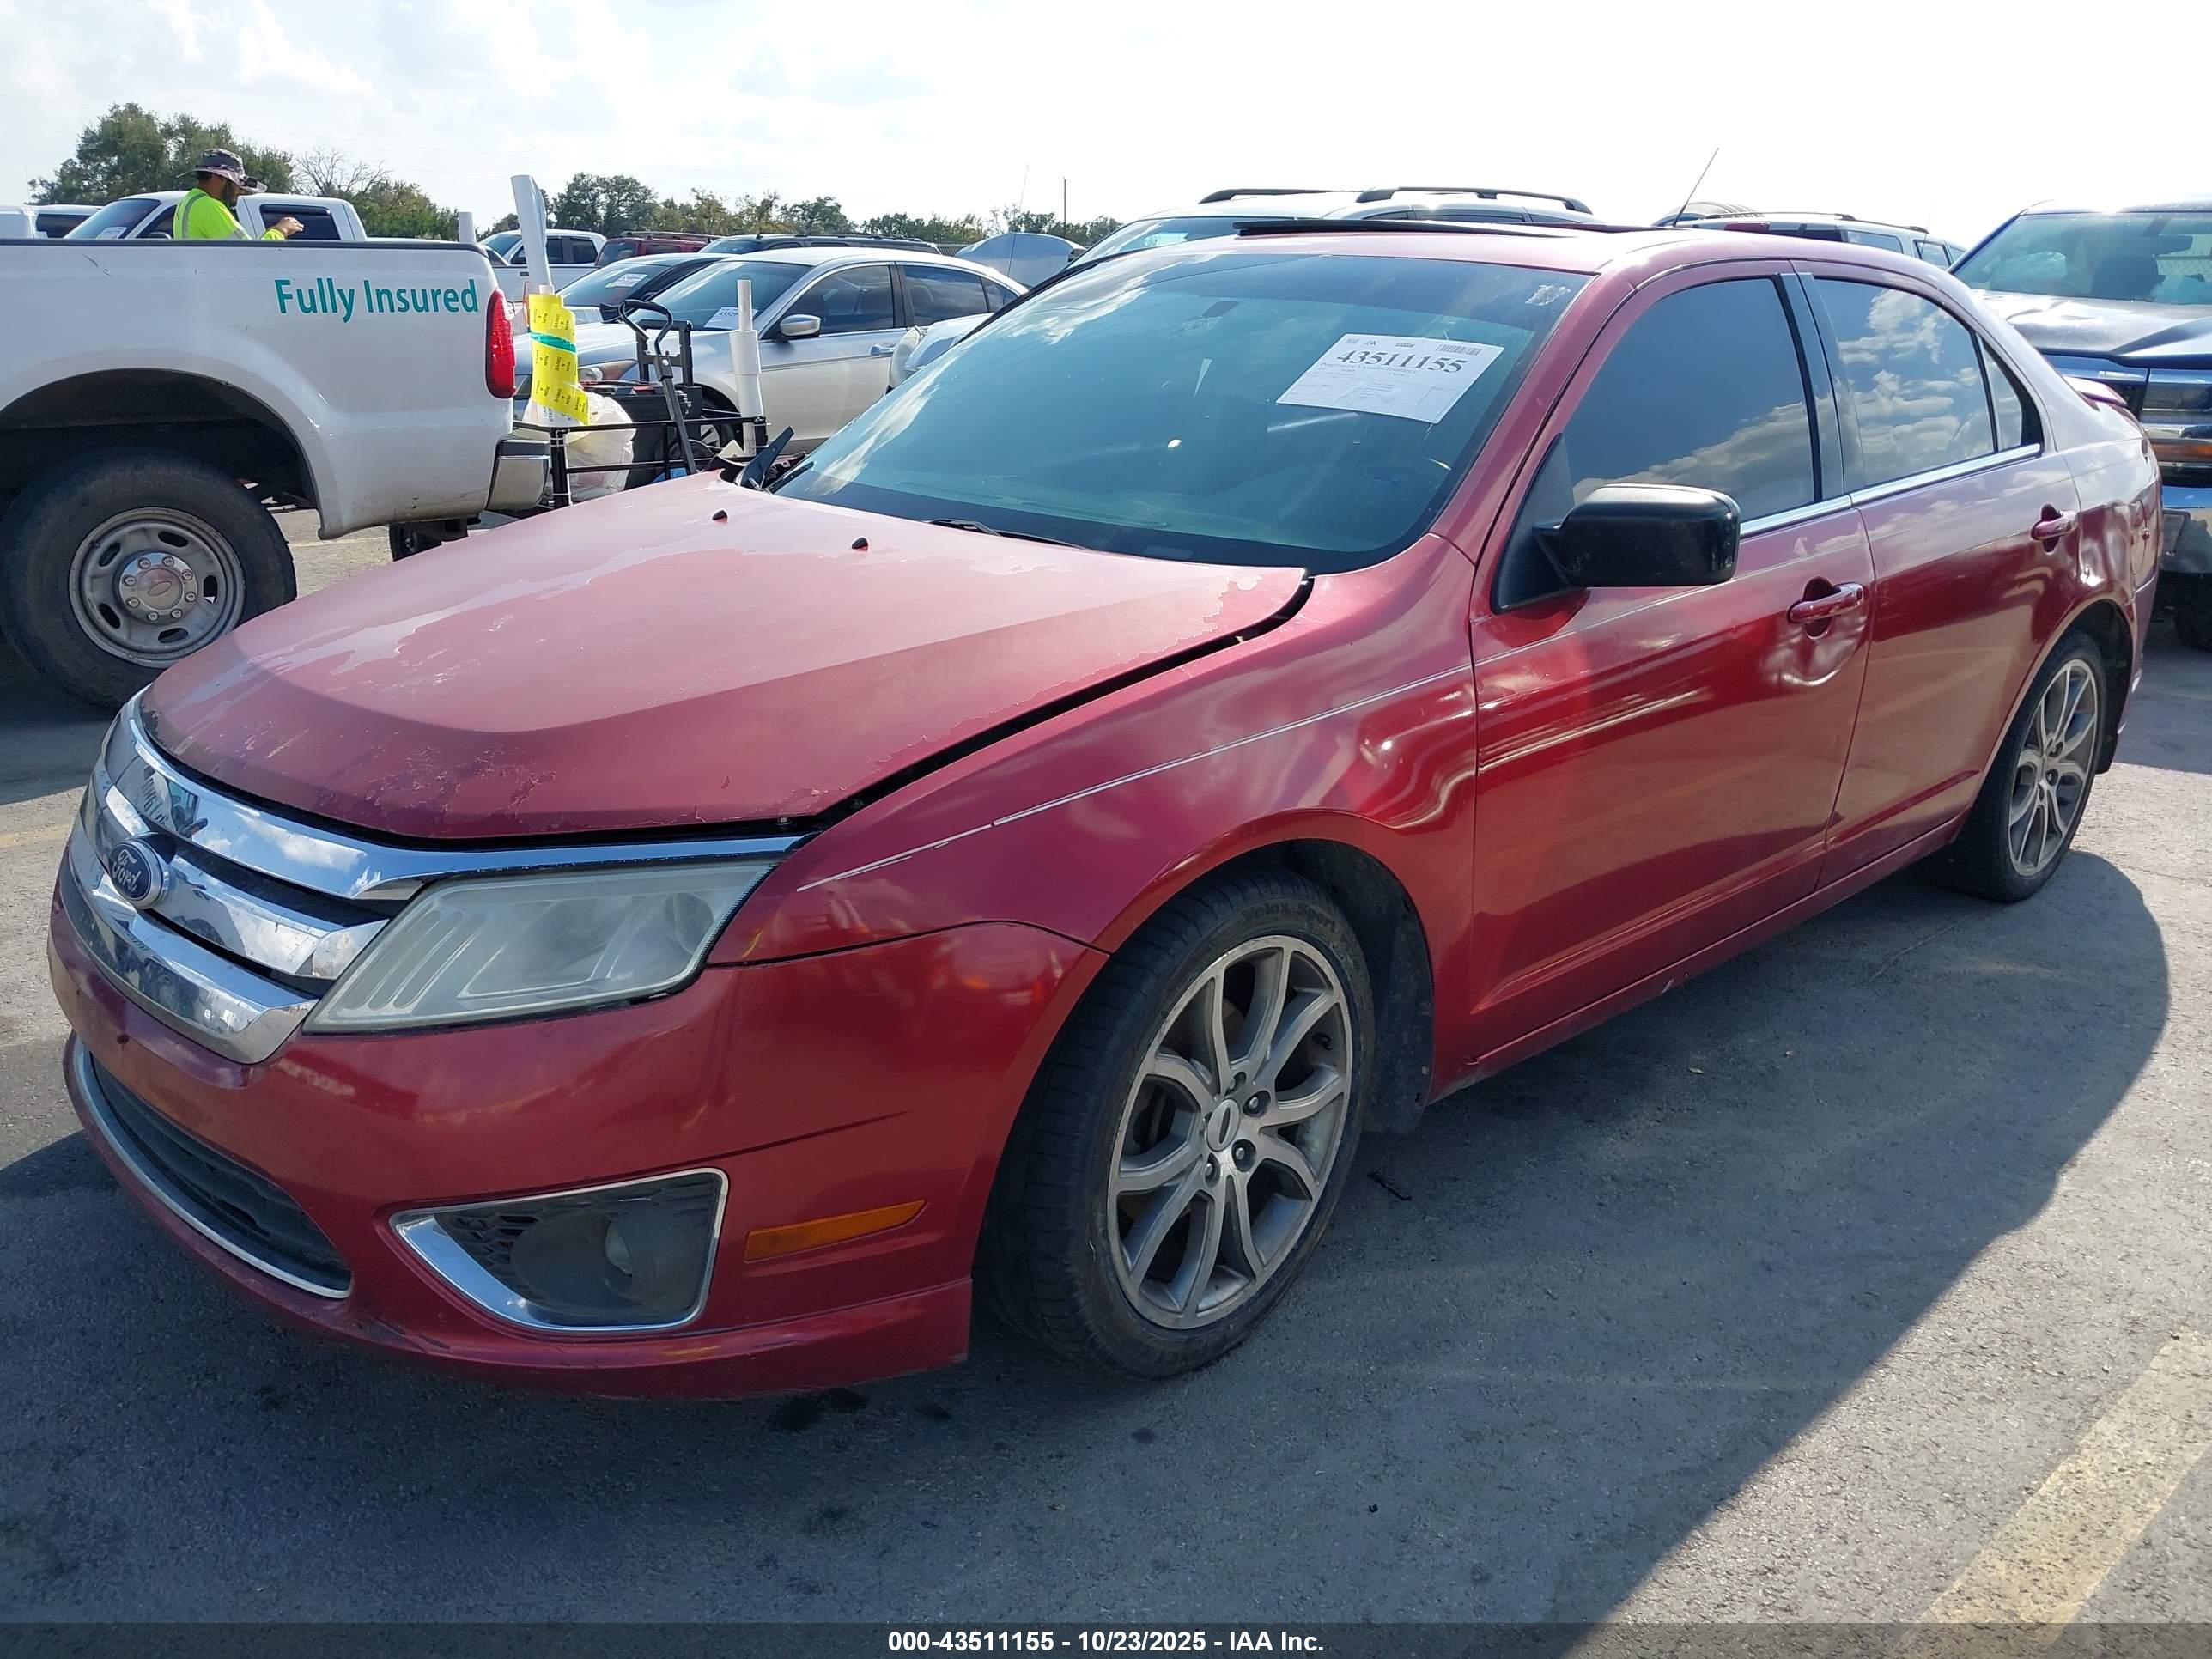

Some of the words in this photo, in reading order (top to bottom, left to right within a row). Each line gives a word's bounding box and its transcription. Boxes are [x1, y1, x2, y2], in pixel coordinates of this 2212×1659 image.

[274, 277, 356, 323] Fully
[363, 278, 478, 314] Insured
[1337, 349, 1468, 374] 43511155
[112, 848, 143, 893] Ford
